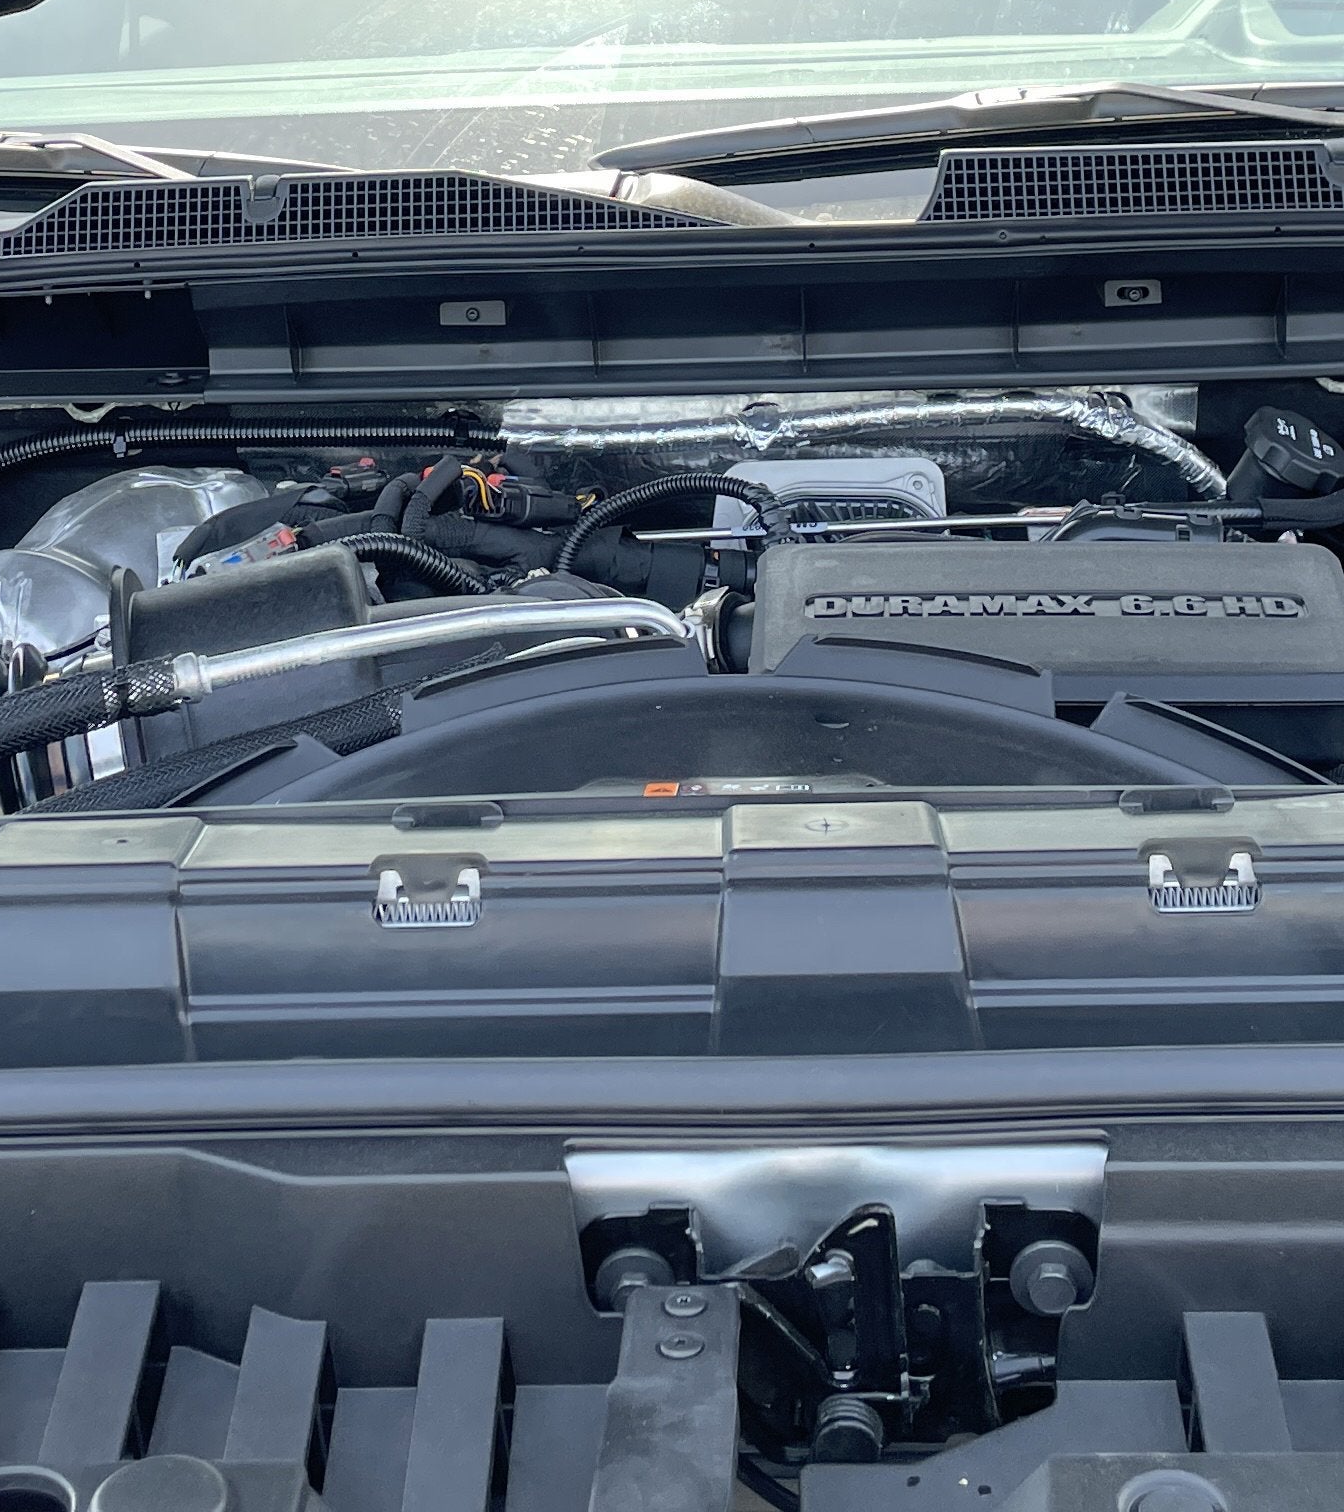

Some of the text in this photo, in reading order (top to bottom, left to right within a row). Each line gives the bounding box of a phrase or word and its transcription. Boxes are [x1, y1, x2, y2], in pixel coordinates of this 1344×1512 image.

[813, 594, 1299, 618] DURAMAX 6.6 HD
